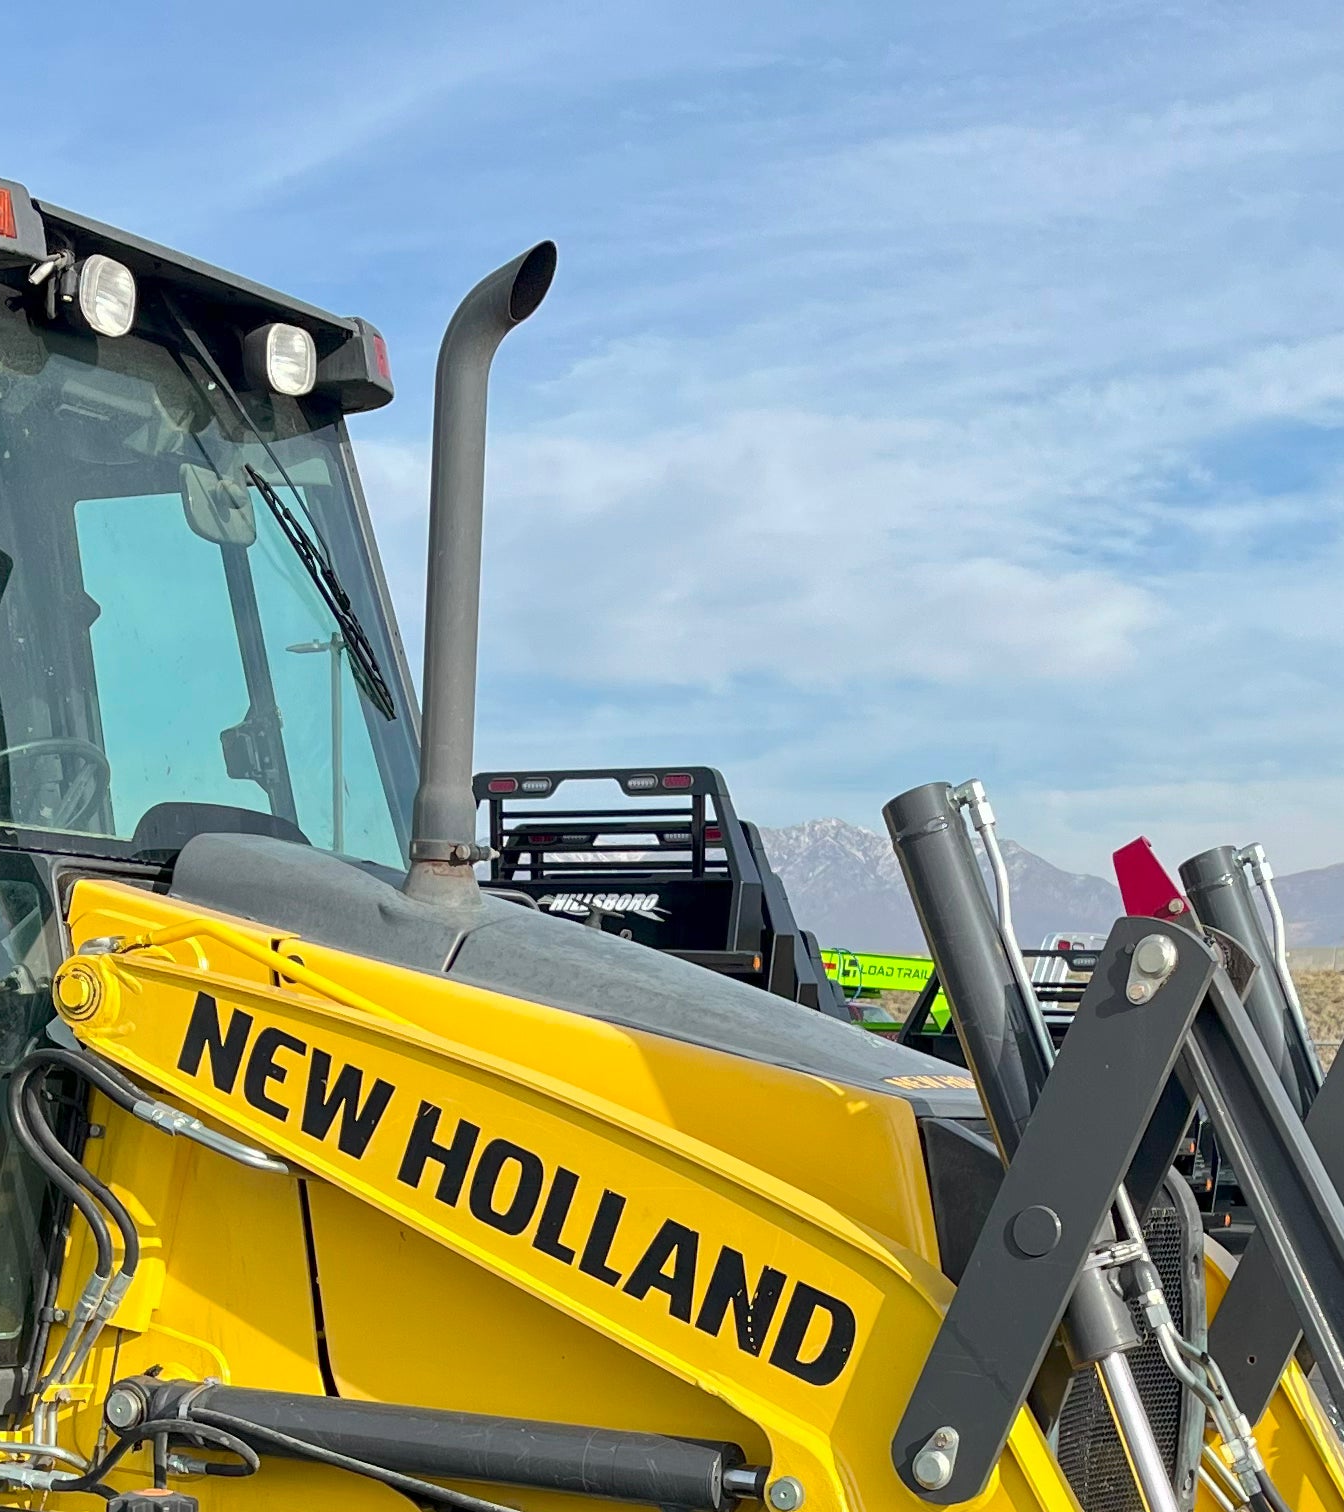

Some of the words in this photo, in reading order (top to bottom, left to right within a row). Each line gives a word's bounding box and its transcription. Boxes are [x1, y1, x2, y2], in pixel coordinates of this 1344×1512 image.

[860, 964, 895, 977] LOAD
[896, 967, 930, 981] TRAIL
[177, 991, 395, 1160] NEW
[396, 1102, 857, 1387] HOLLAND
